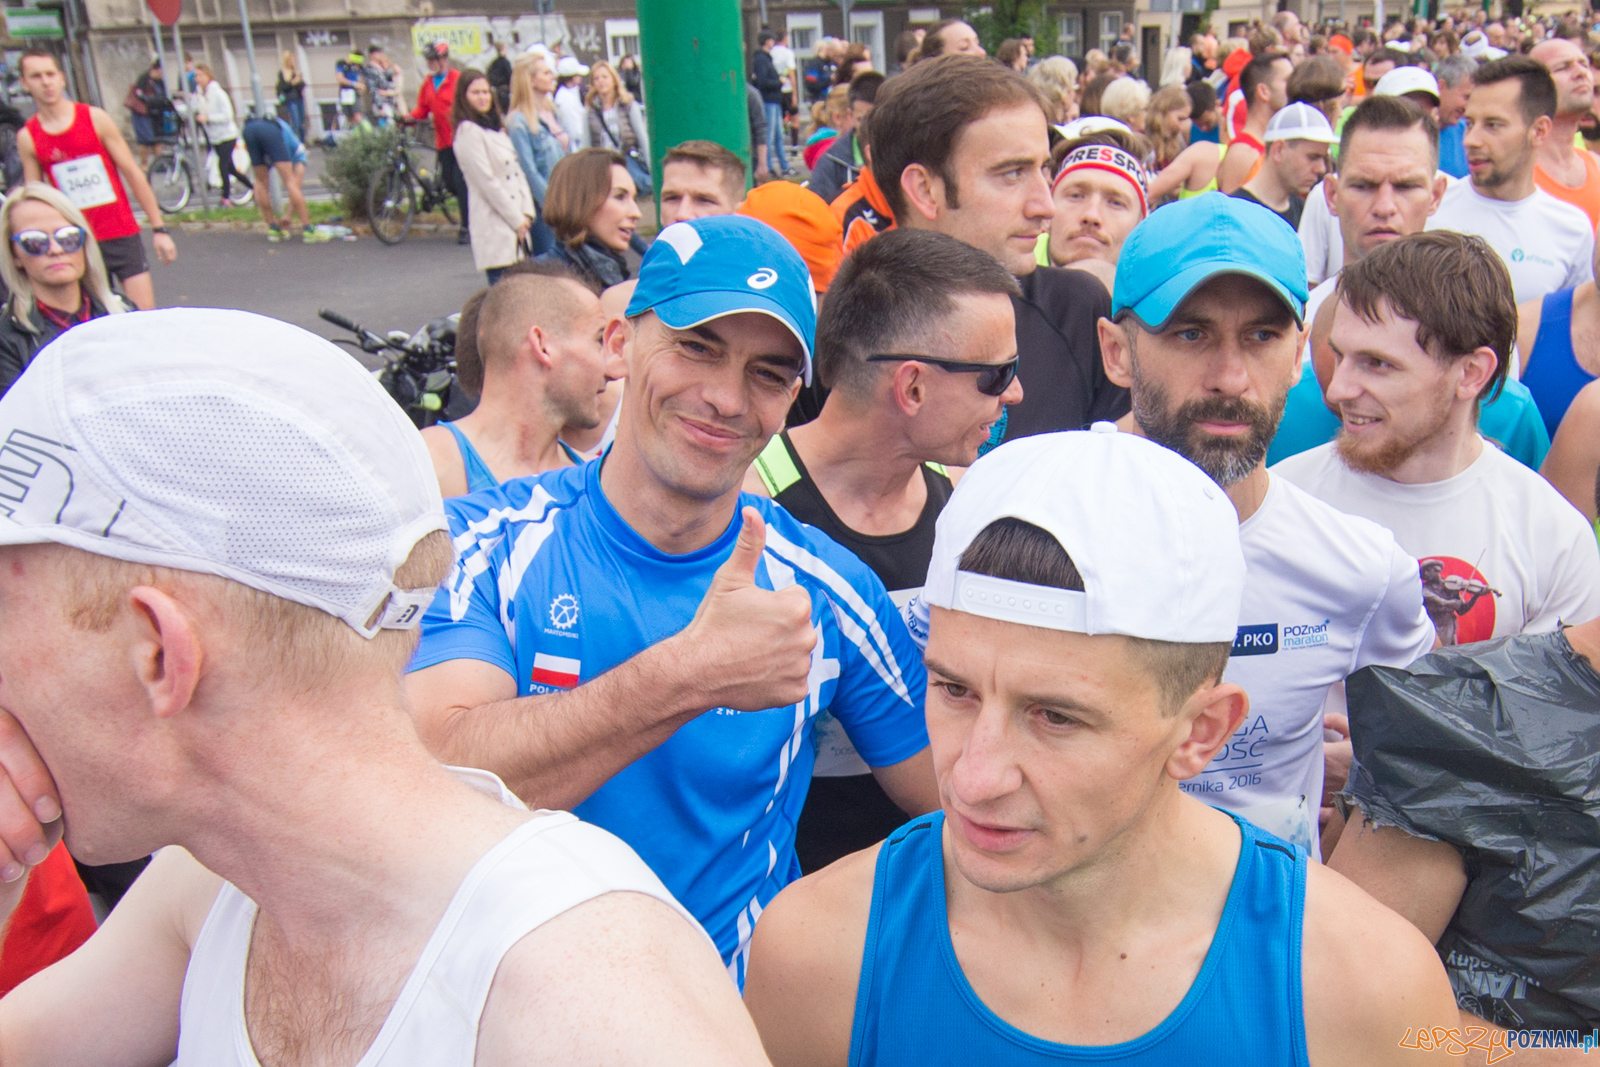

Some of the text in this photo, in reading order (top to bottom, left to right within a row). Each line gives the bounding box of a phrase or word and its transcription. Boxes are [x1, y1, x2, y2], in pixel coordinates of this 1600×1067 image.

[1057, 147, 1147, 192] PRESSPO
[66, 173, 101, 191] 2460
[1283, 633, 1329, 647] maraton
[1178, 772, 1262, 793] ernika 2016
